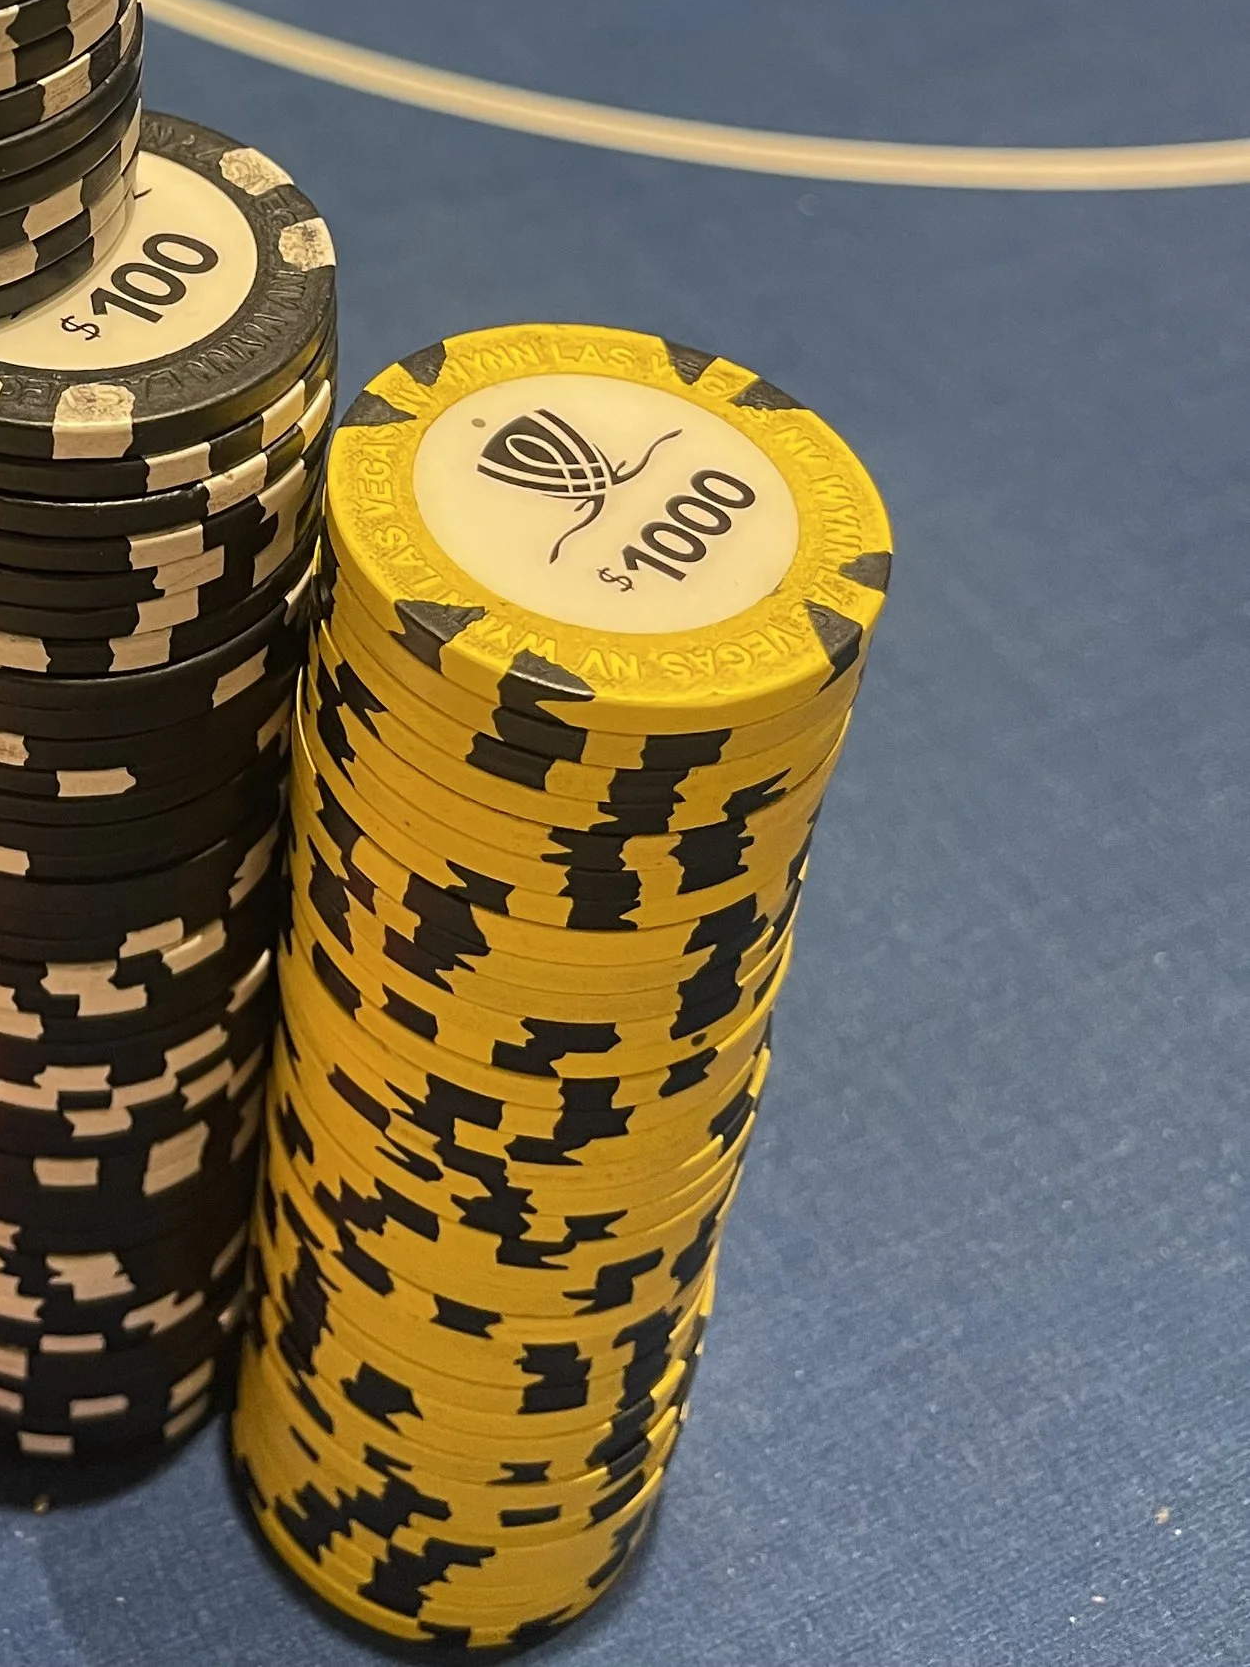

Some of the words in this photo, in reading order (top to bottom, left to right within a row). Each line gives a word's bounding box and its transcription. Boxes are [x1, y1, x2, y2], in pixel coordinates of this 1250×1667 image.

[61, 233, 220, 342] $100
[550, 341, 637, 368] LAS
[371, 523, 444, 589] LAS
[596, 469, 757, 593] $1000
[575, 647, 642, 681] NV
